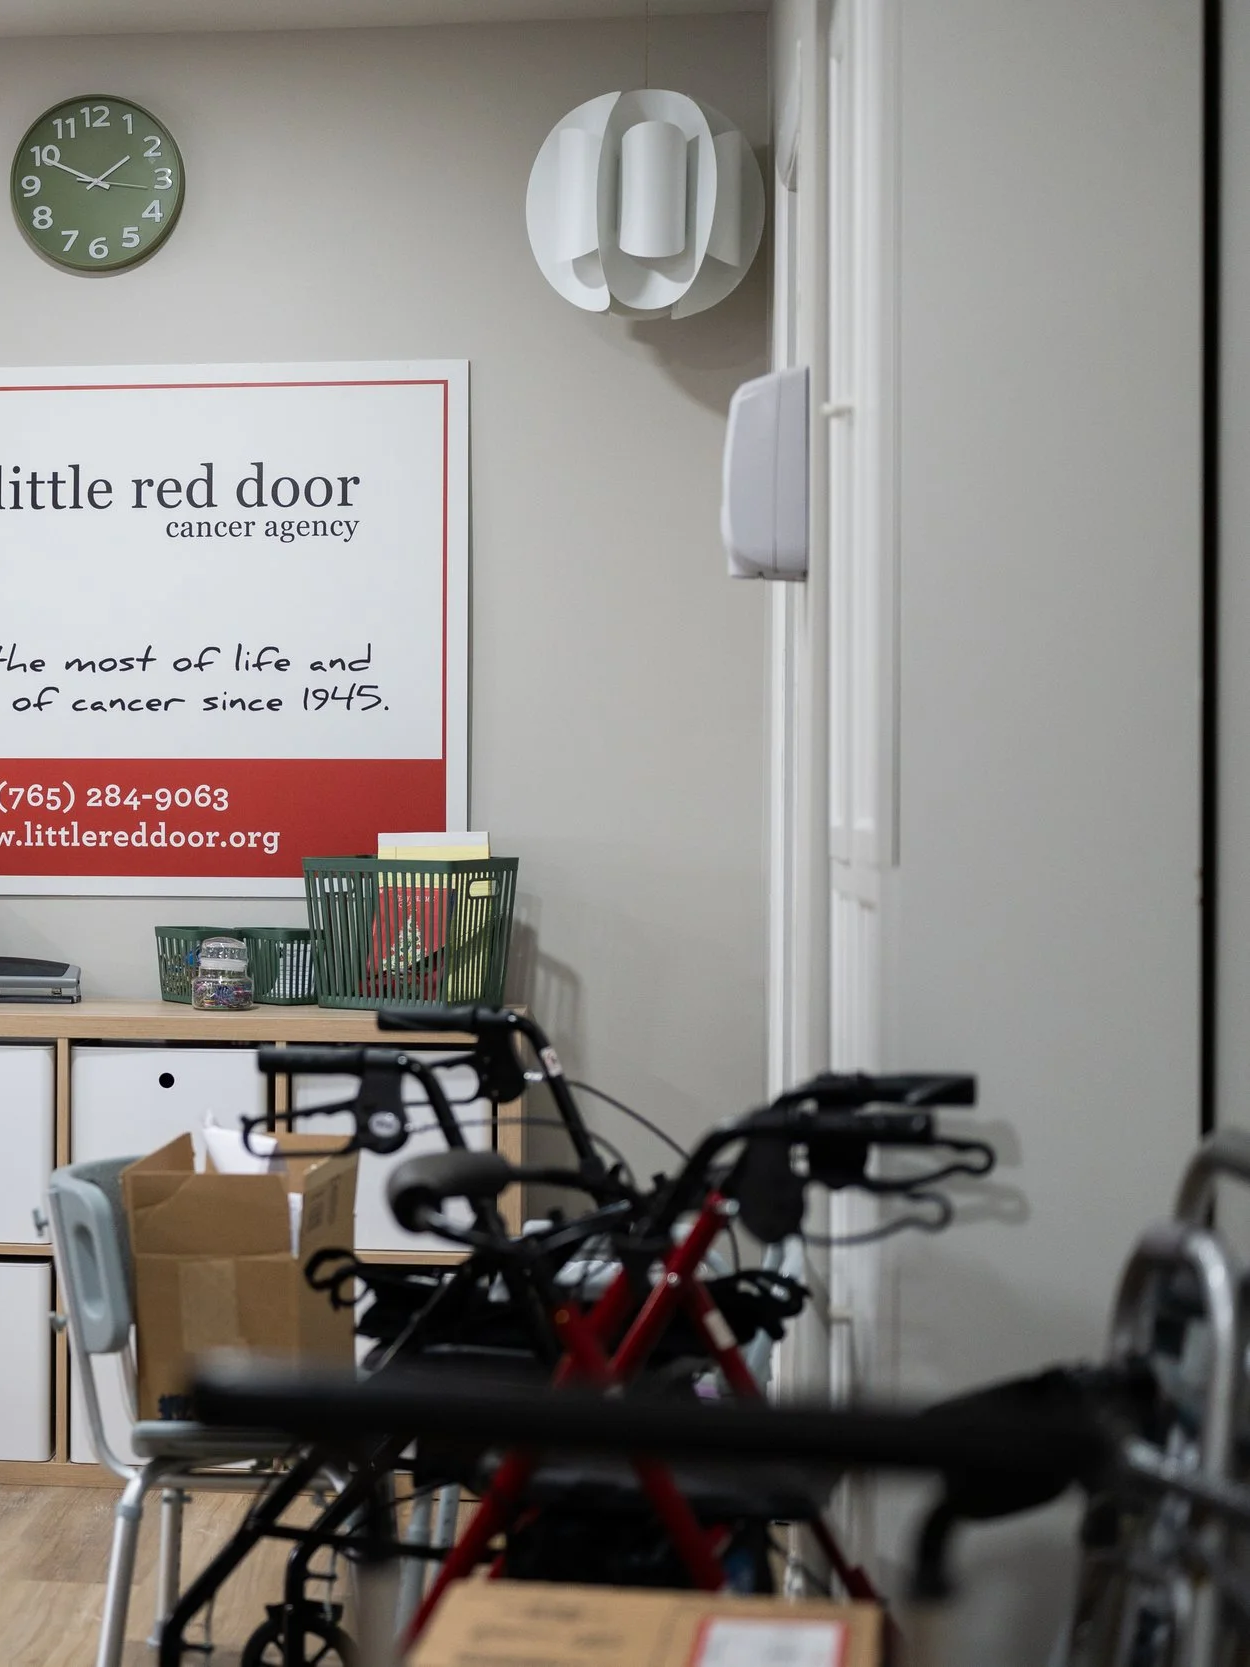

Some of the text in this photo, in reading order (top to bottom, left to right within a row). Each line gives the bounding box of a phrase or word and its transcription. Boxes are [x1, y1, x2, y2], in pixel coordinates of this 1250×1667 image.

[52, 117, 76, 139] 11
[80, 105, 111, 128] 12
[122, 113, 133, 135] 1
[30, 144, 61, 167] 10
[143, 135, 162, 158] 2
[21, 175, 42, 198] 9
[154, 167, 173, 190] 3
[32, 205, 53, 230] 8
[142, 199, 163, 223] 4
[61, 230, 79, 252] 7
[88, 236, 109, 260] 6
[121, 226, 141, 248] 5
[131, 462, 218, 509] red
[236, 461, 361, 508] door
[165, 520, 360, 543] cancer agency
[64, 645, 157, 674] most
[172, 646, 221, 673] of
[235, 642, 291, 673] life
[309, 642, 372, 673] and
[11, 686, 60, 712] of
[71, 697, 186, 713] cancer
[202, 691, 283, 712] since
[303, 682, 390, 712] 1945.
[86, 783, 230, 812] 284-9063
